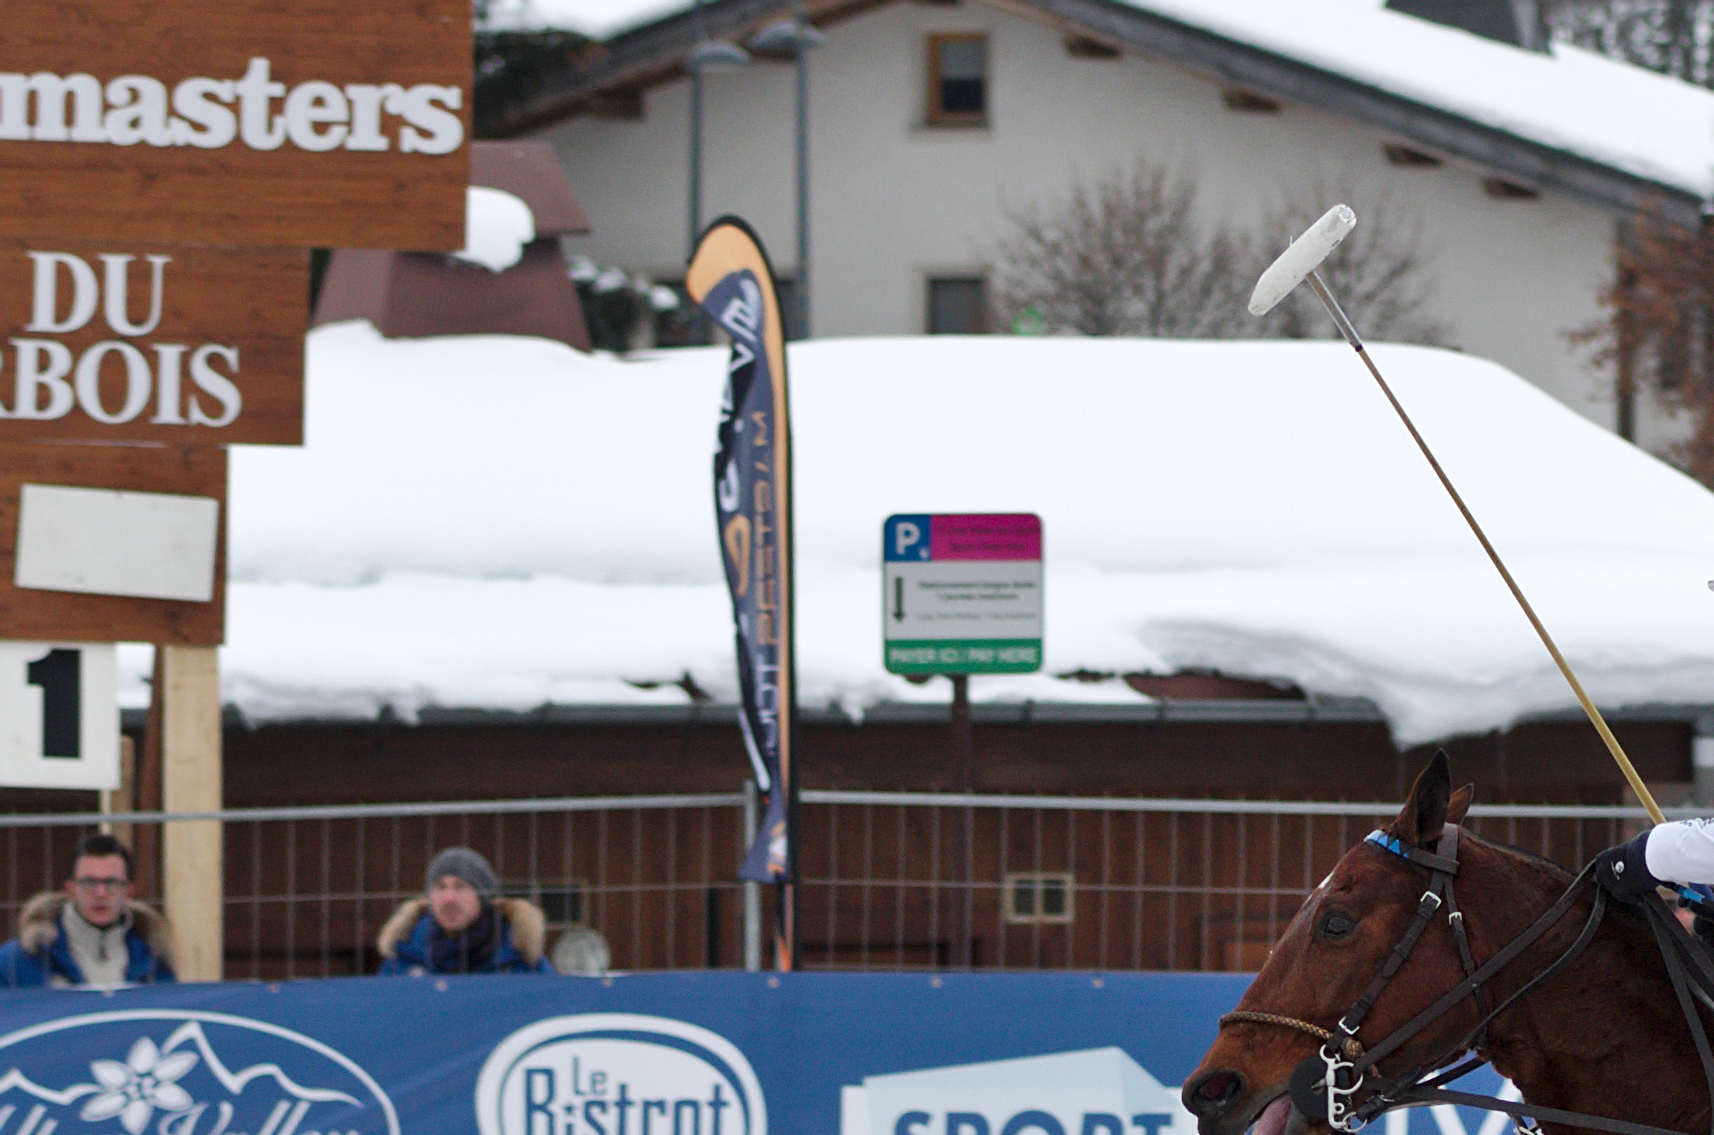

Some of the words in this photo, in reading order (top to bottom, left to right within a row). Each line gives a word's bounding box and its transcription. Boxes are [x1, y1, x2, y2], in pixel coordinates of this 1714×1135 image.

[0, 57, 465, 155] masters
[24, 250, 173, 337] DU
[0, 336, 243, 428] BOIS
[895, 521, 921, 555] P
[26, 648, 81, 758] 1
[572, 1056, 608, 1096] Le
